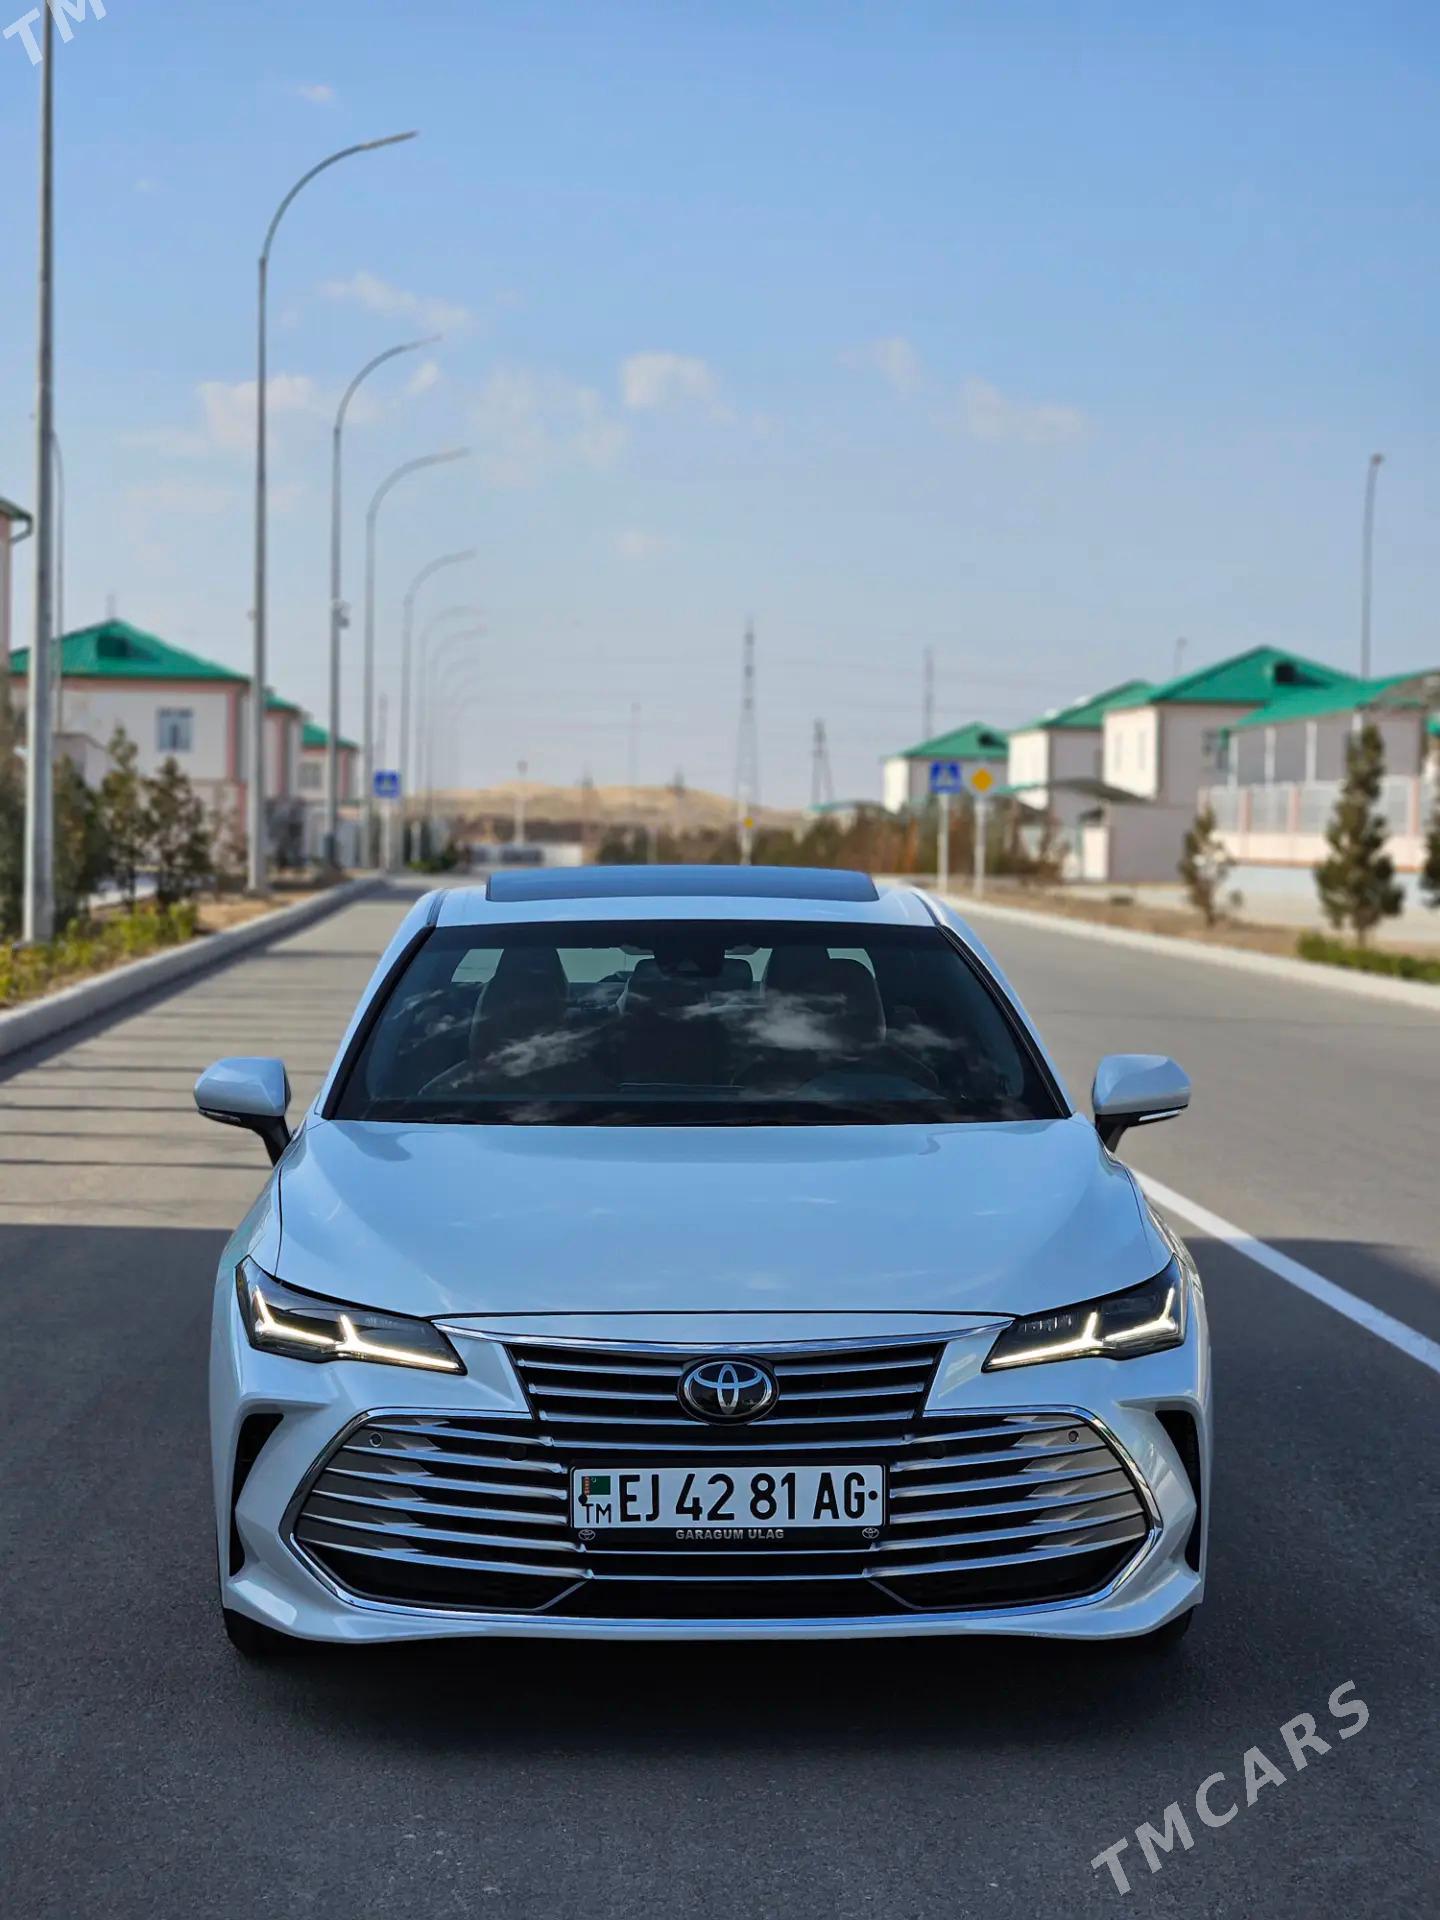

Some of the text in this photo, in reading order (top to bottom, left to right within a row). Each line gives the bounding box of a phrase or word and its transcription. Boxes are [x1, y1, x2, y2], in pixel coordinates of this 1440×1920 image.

[618, 1471, 866, 1522] EJ 42 81 AG
[581, 1503, 612, 1524] TM
[675, 1528, 785, 1541] GARAGUM ULAG
